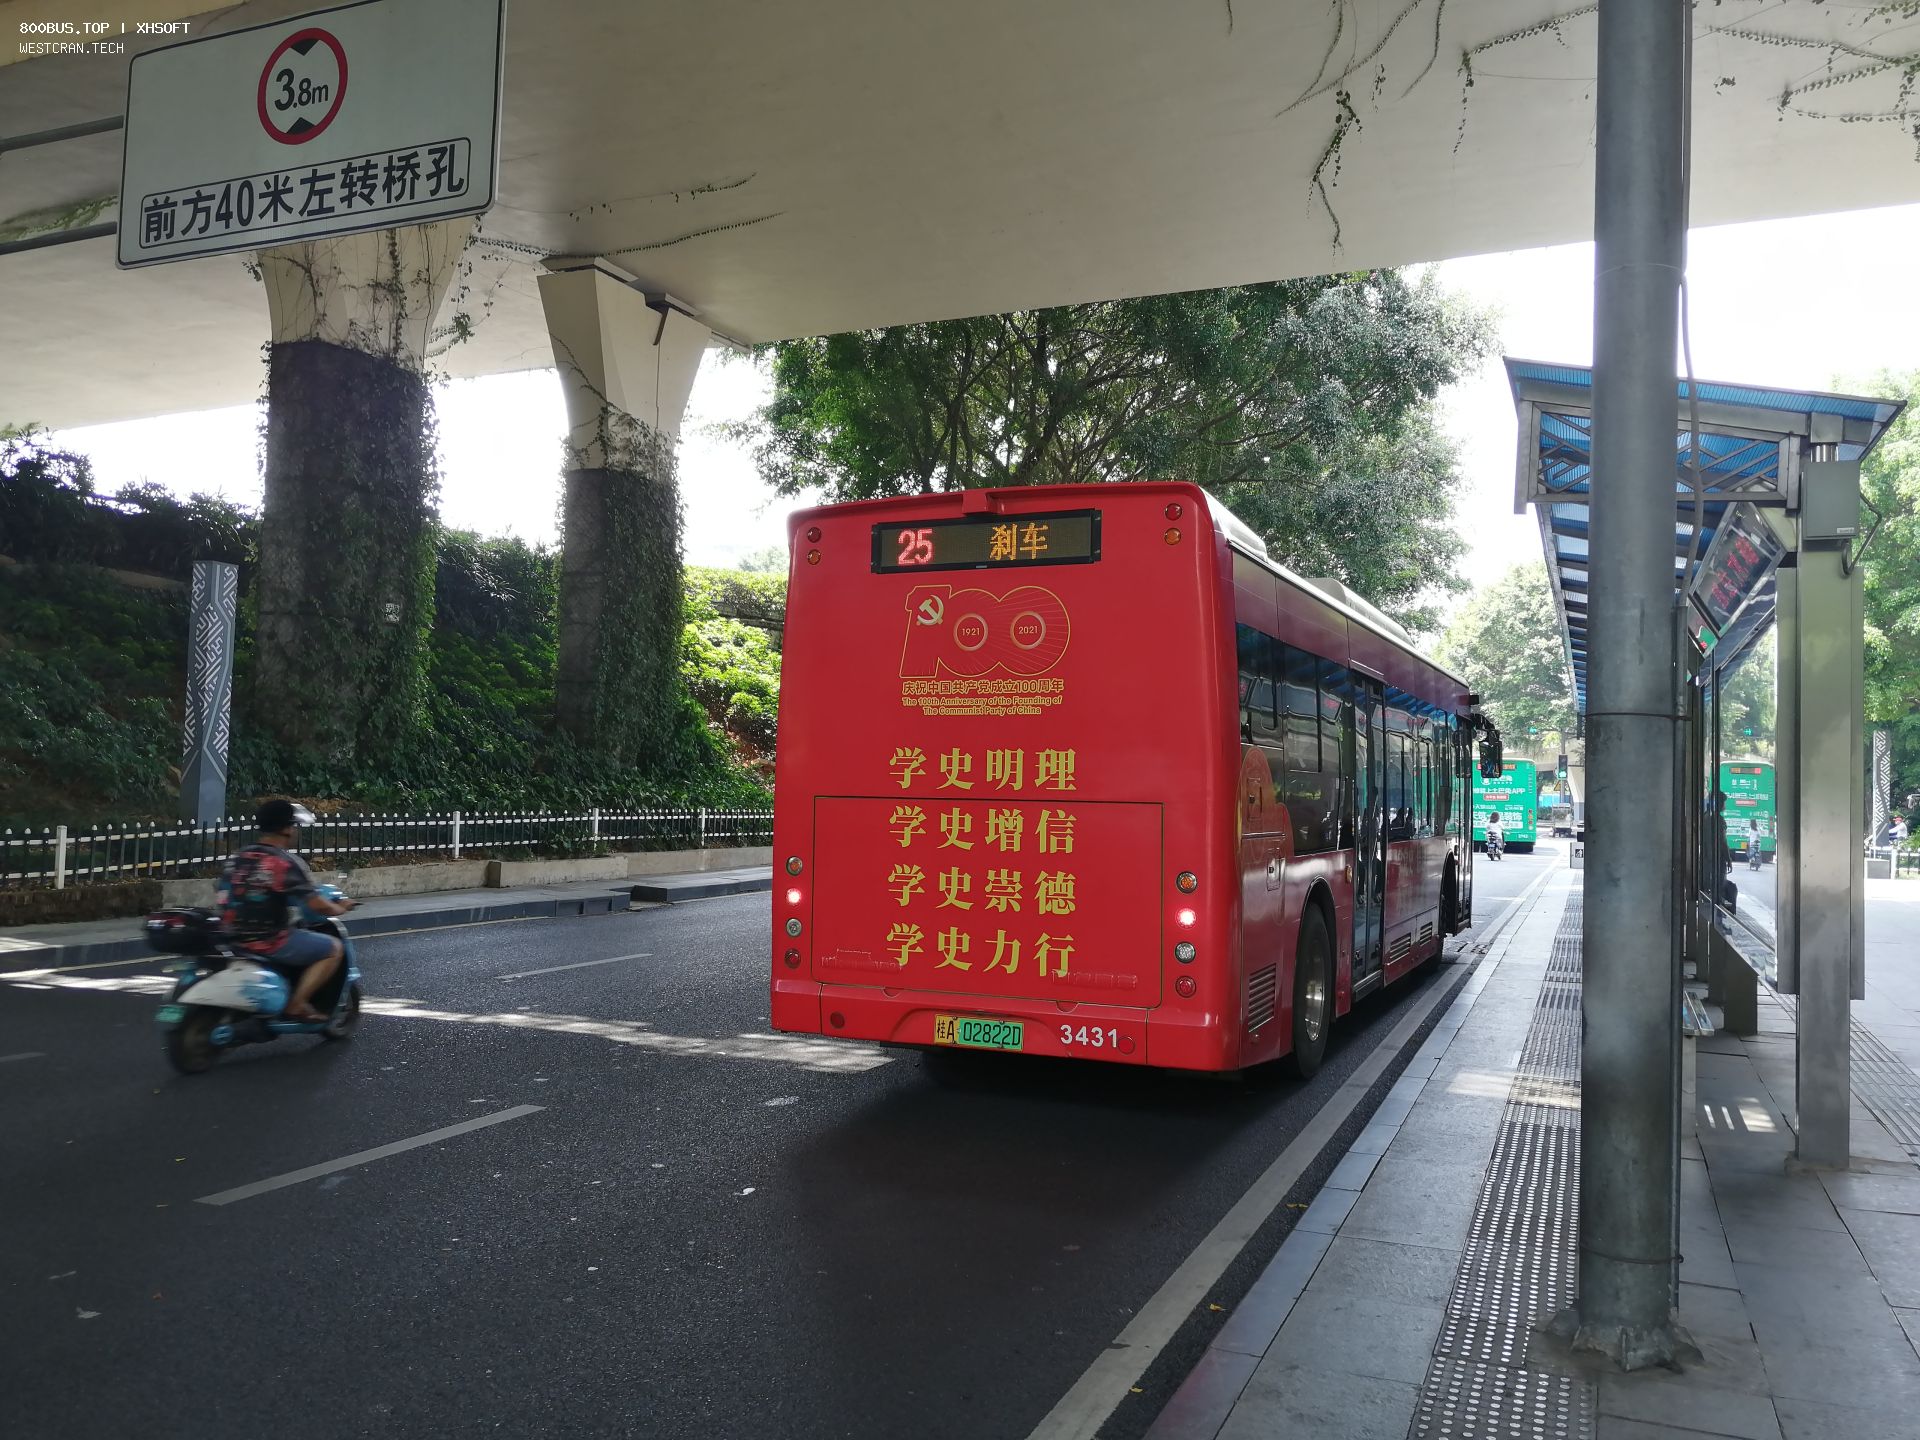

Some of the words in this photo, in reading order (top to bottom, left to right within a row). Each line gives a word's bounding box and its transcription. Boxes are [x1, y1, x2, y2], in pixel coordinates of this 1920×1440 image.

[274, 68, 329, 111] 3.8m
[143, 143, 466, 245] 前方40米左转桥孔
[897, 528, 934, 565] 25
[989, 522, 1049, 561] 刹车
[961, 627, 981, 636] 1921
[1018, 625, 1038, 635] 2021
[902, 679, 1064, 695] 庆祝中国共产党成立100周年
[902, 697, 917, 706] The
[918, 697, 939, 706] 100th
[940, 696, 987, 707] Anniversary
[988, 696, 997, 706] of
[997, 696, 1012, 705] the
[1013, 696, 1051, 707] Founding
[1052, 695, 1062, 705] of
[923, 707, 938, 716] The
[939, 706, 984, 716] Communist
[984, 706, 1006, 717] Party
[1007, 706, 1017, 715] of
[1018, 705, 1042, 715] China
[888, 747, 1078, 792] 学史明理
[888, 805, 1078, 855] 学史增信
[887, 863, 1077, 916] 学史崇德
[886, 922, 1077, 978] 学史力行
[1060, 1024, 1118, 1048] 3431
